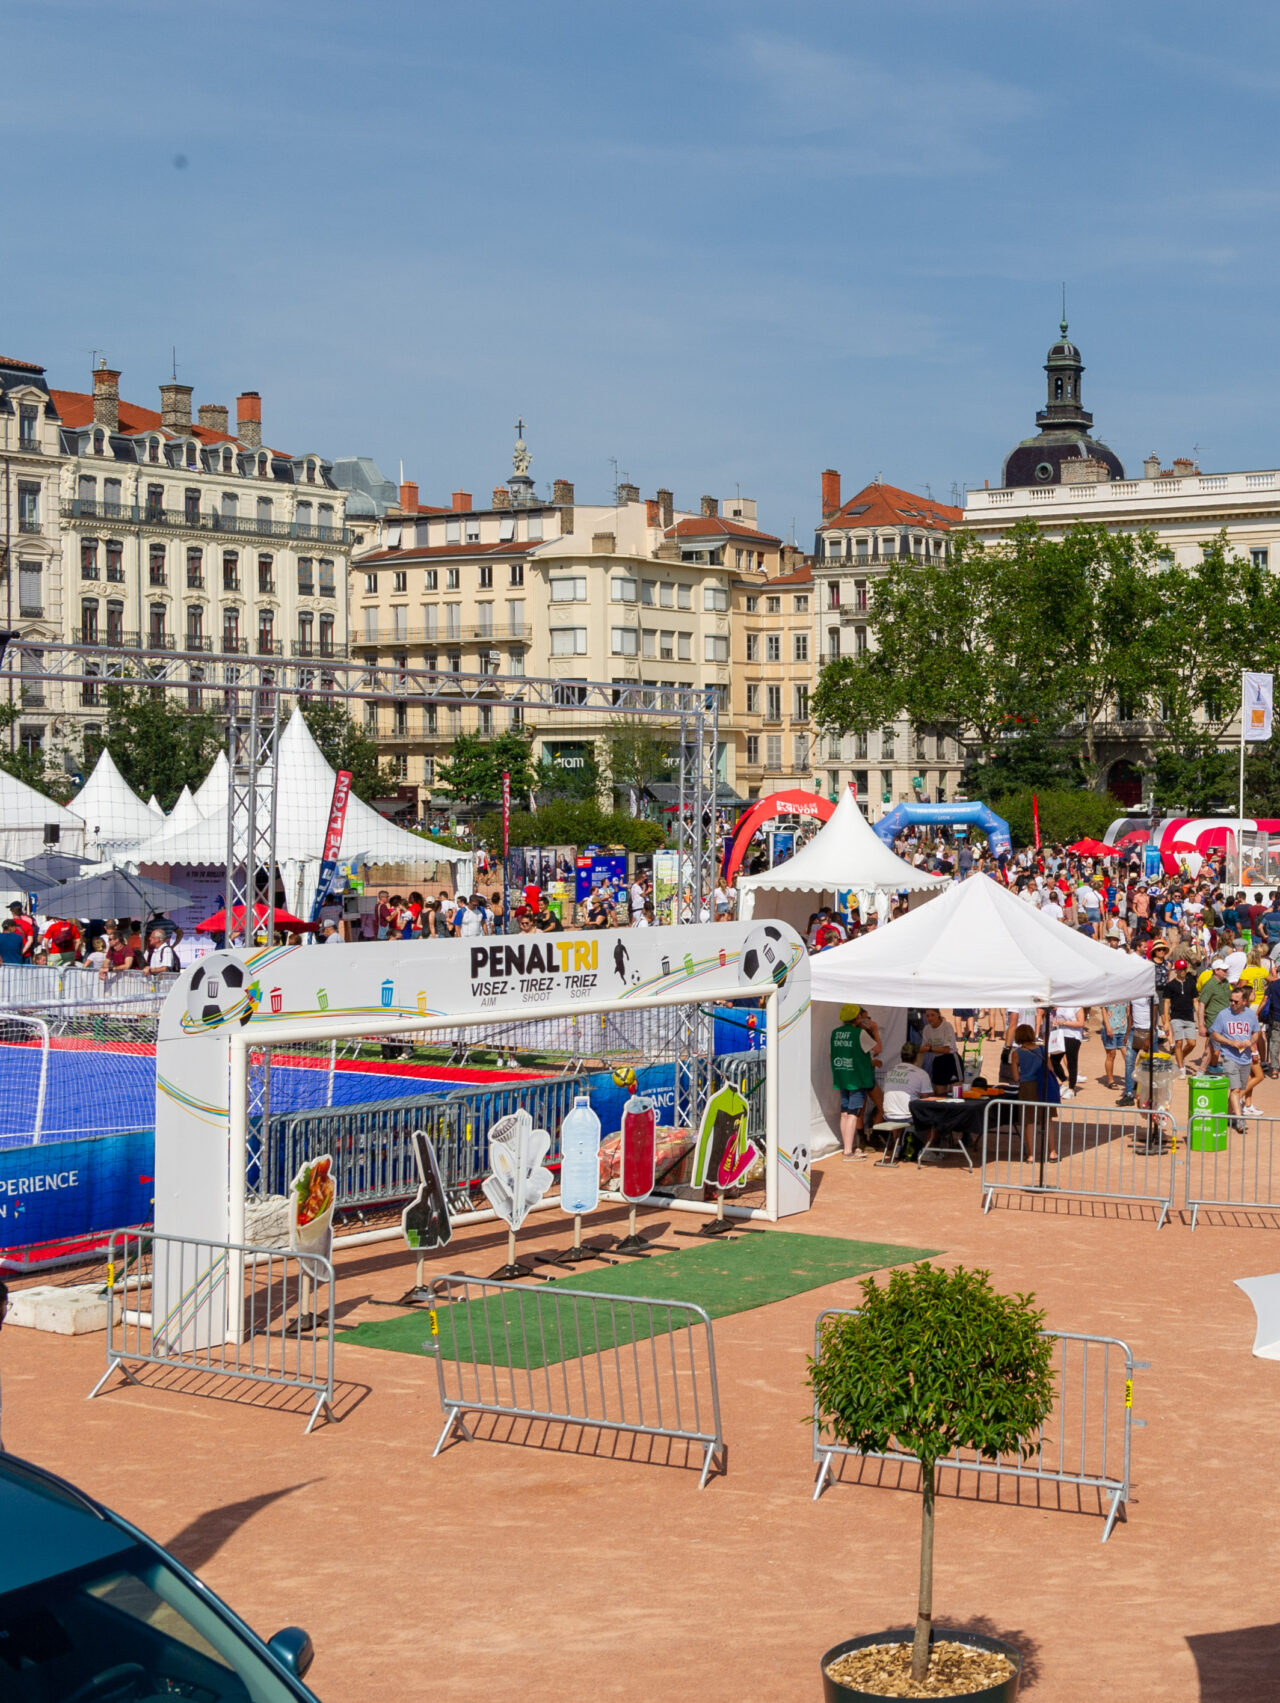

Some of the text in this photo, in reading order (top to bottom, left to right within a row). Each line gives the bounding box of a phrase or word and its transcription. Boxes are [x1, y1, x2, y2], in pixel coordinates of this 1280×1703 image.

[331, 776, 350, 829] LYON
[792, 806, 818, 814] LYON
[328, 835, 341, 862] DE
[471, 940, 598, 979] PENALTRI
[471, 981, 508, 997] VISEZ
[520, 977, 554, 992] TIREZ
[565, 974, 597, 989] TRIEZ
[481, 988, 591, 1007] AIM SHOOT SORT
[1228, 1022, 1250, 1035] USA
